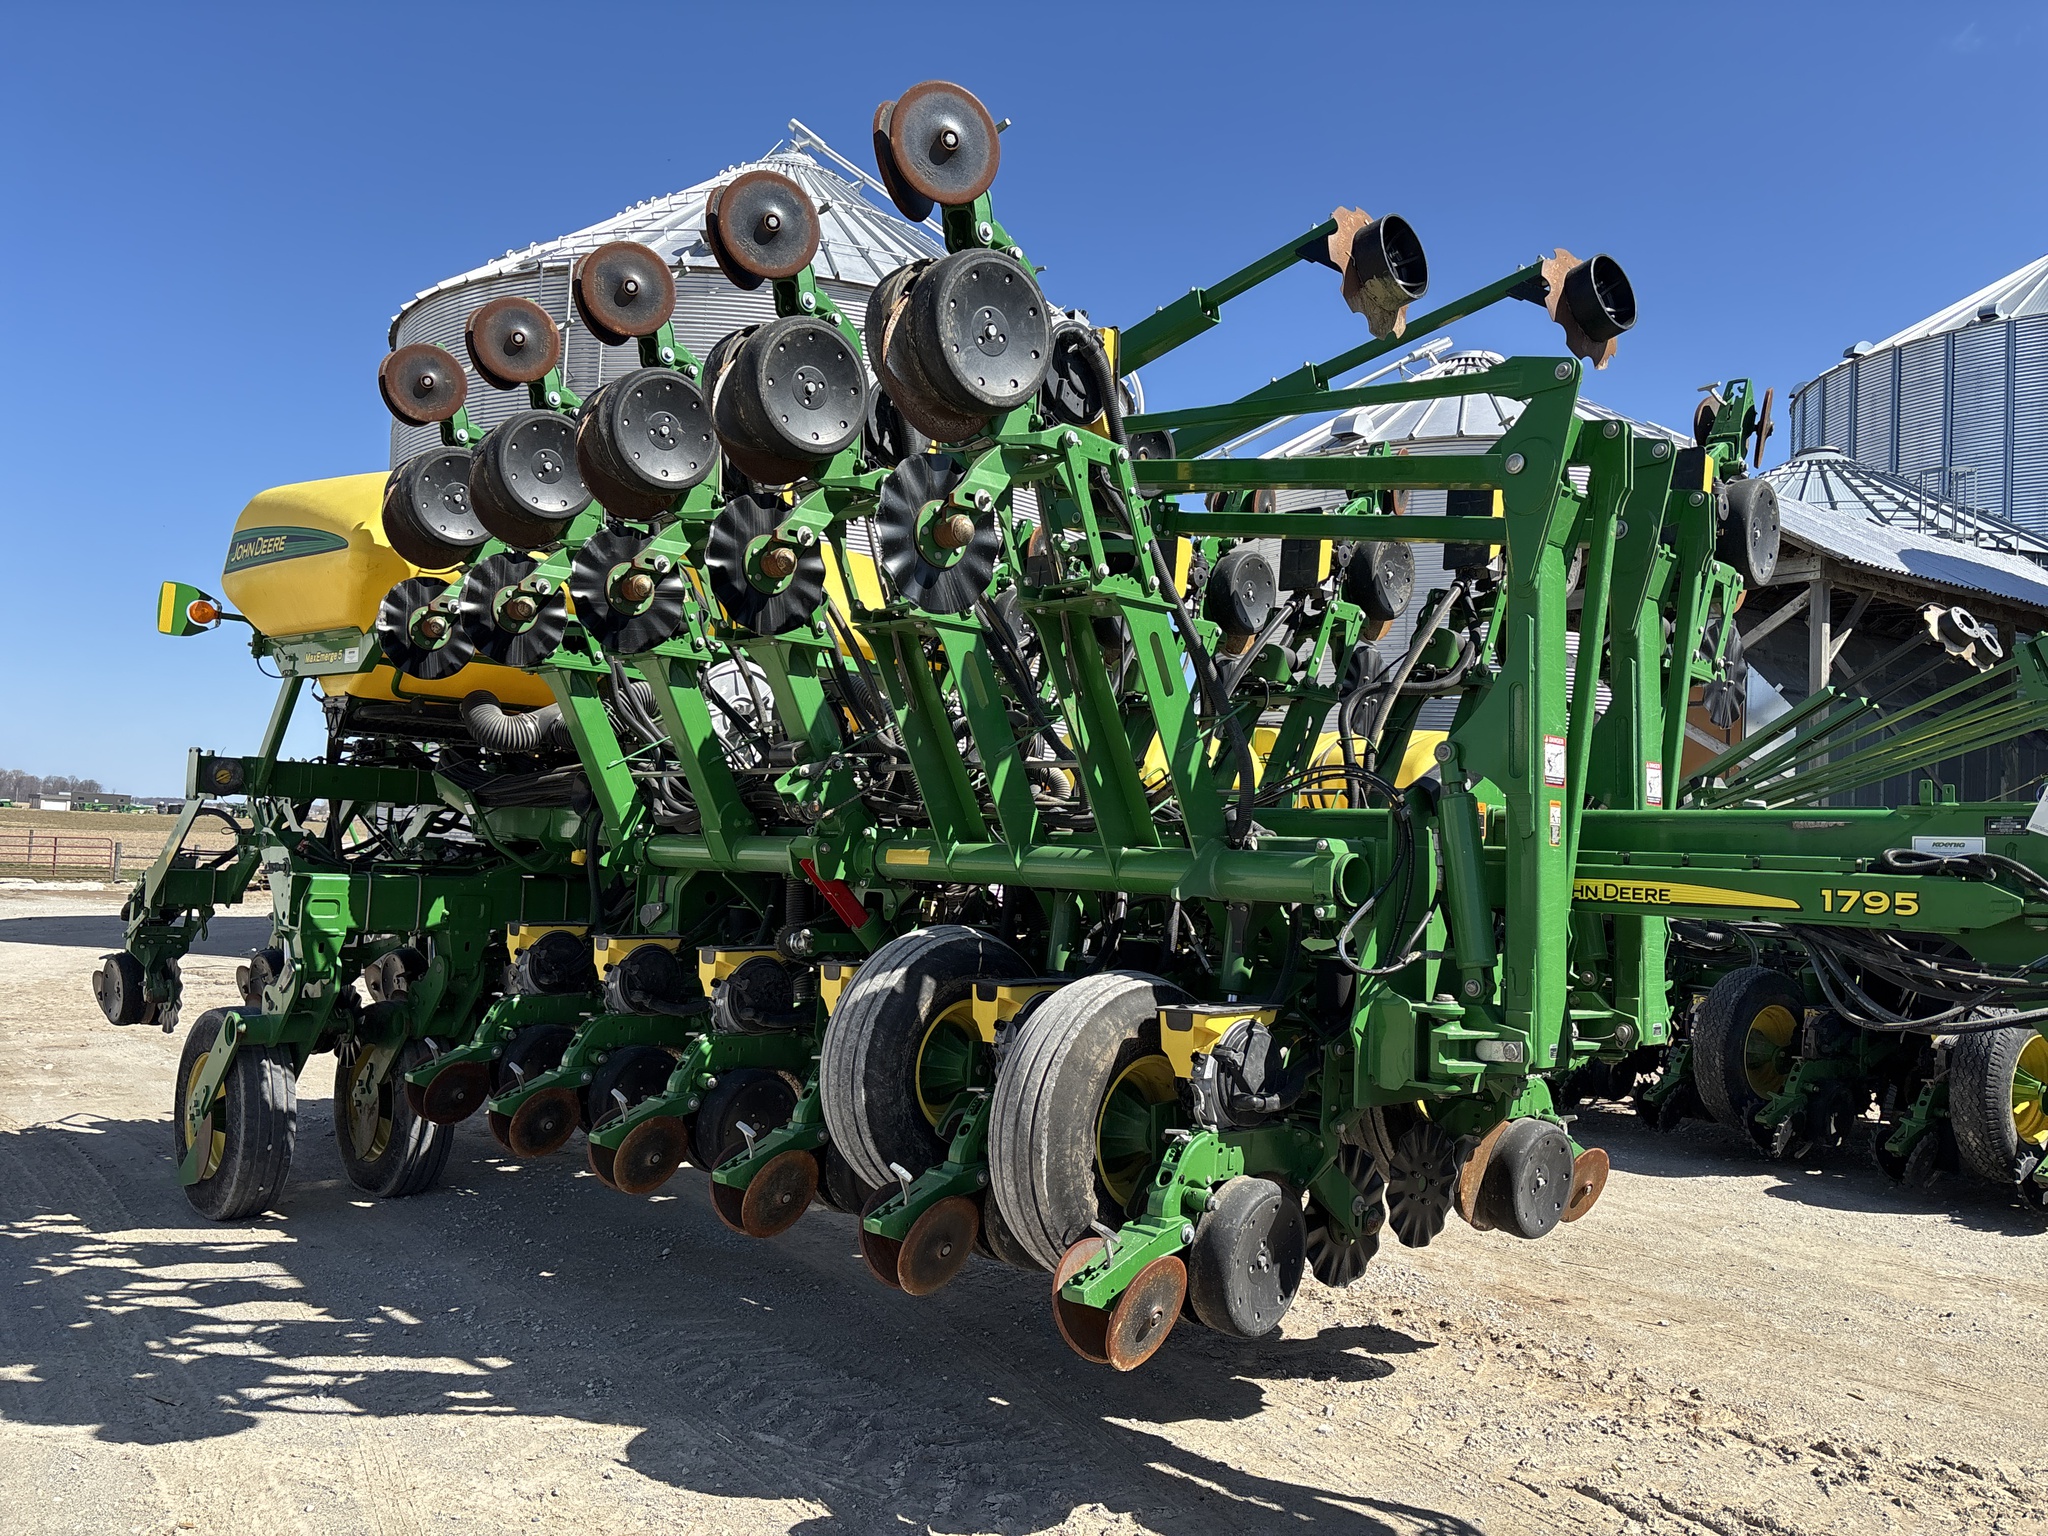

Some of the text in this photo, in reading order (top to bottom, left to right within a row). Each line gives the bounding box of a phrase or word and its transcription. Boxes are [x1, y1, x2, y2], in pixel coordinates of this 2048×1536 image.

[231, 535, 288, 562] JOHN DEERE
[305, 649, 343, 663] MaxEmerge 5
[1572, 883, 1671, 902] HN DEERE
[1820, 889, 1920, 916] 1795
